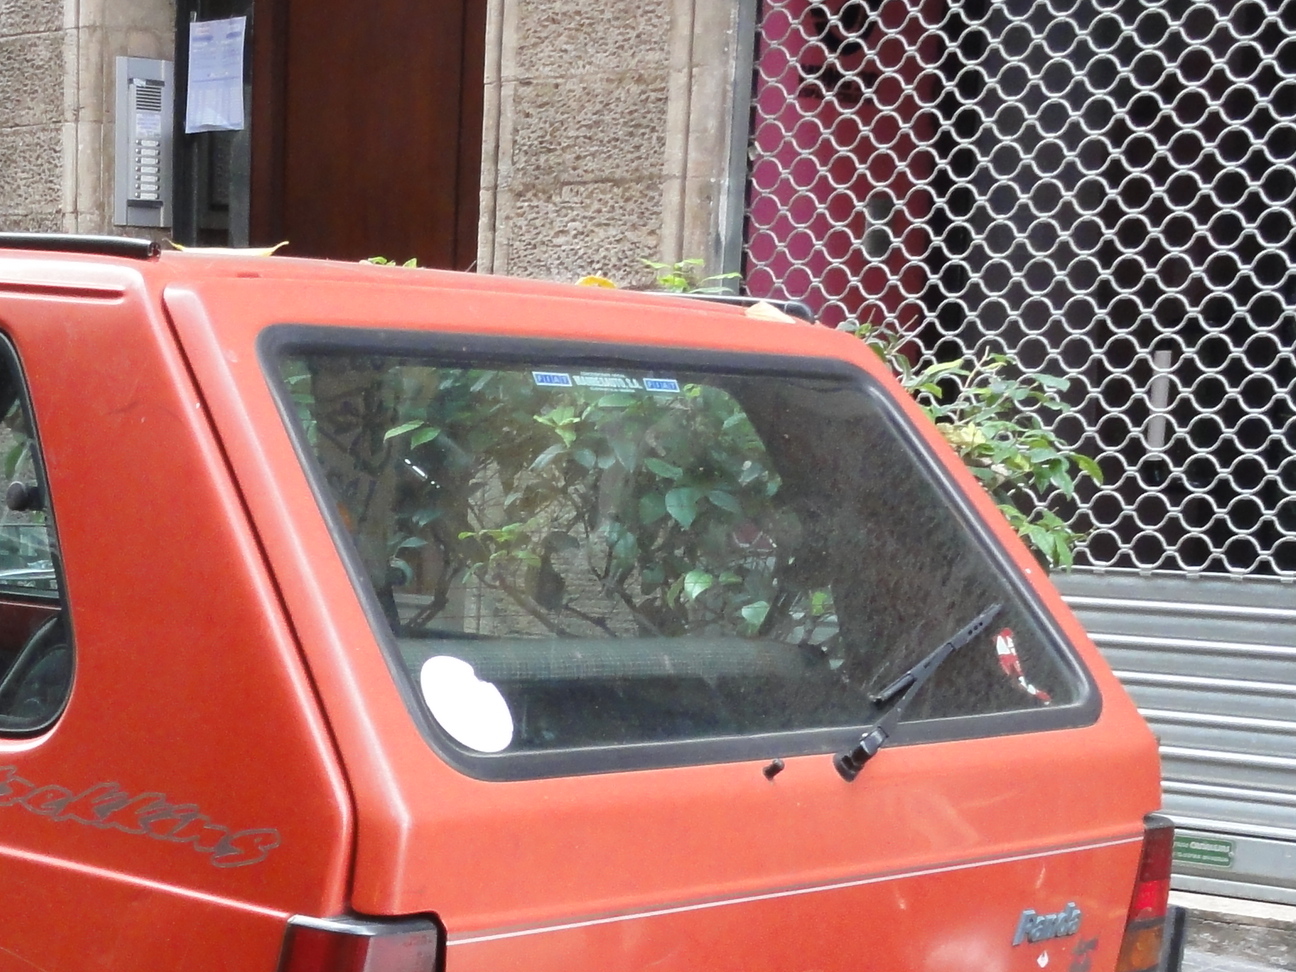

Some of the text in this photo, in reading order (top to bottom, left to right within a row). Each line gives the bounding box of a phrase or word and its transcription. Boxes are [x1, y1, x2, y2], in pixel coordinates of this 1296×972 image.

[535, 373, 570, 386] FIAT
[646, 378, 678, 391] FIAT
[1012, 902, 1081, 947] Panda
